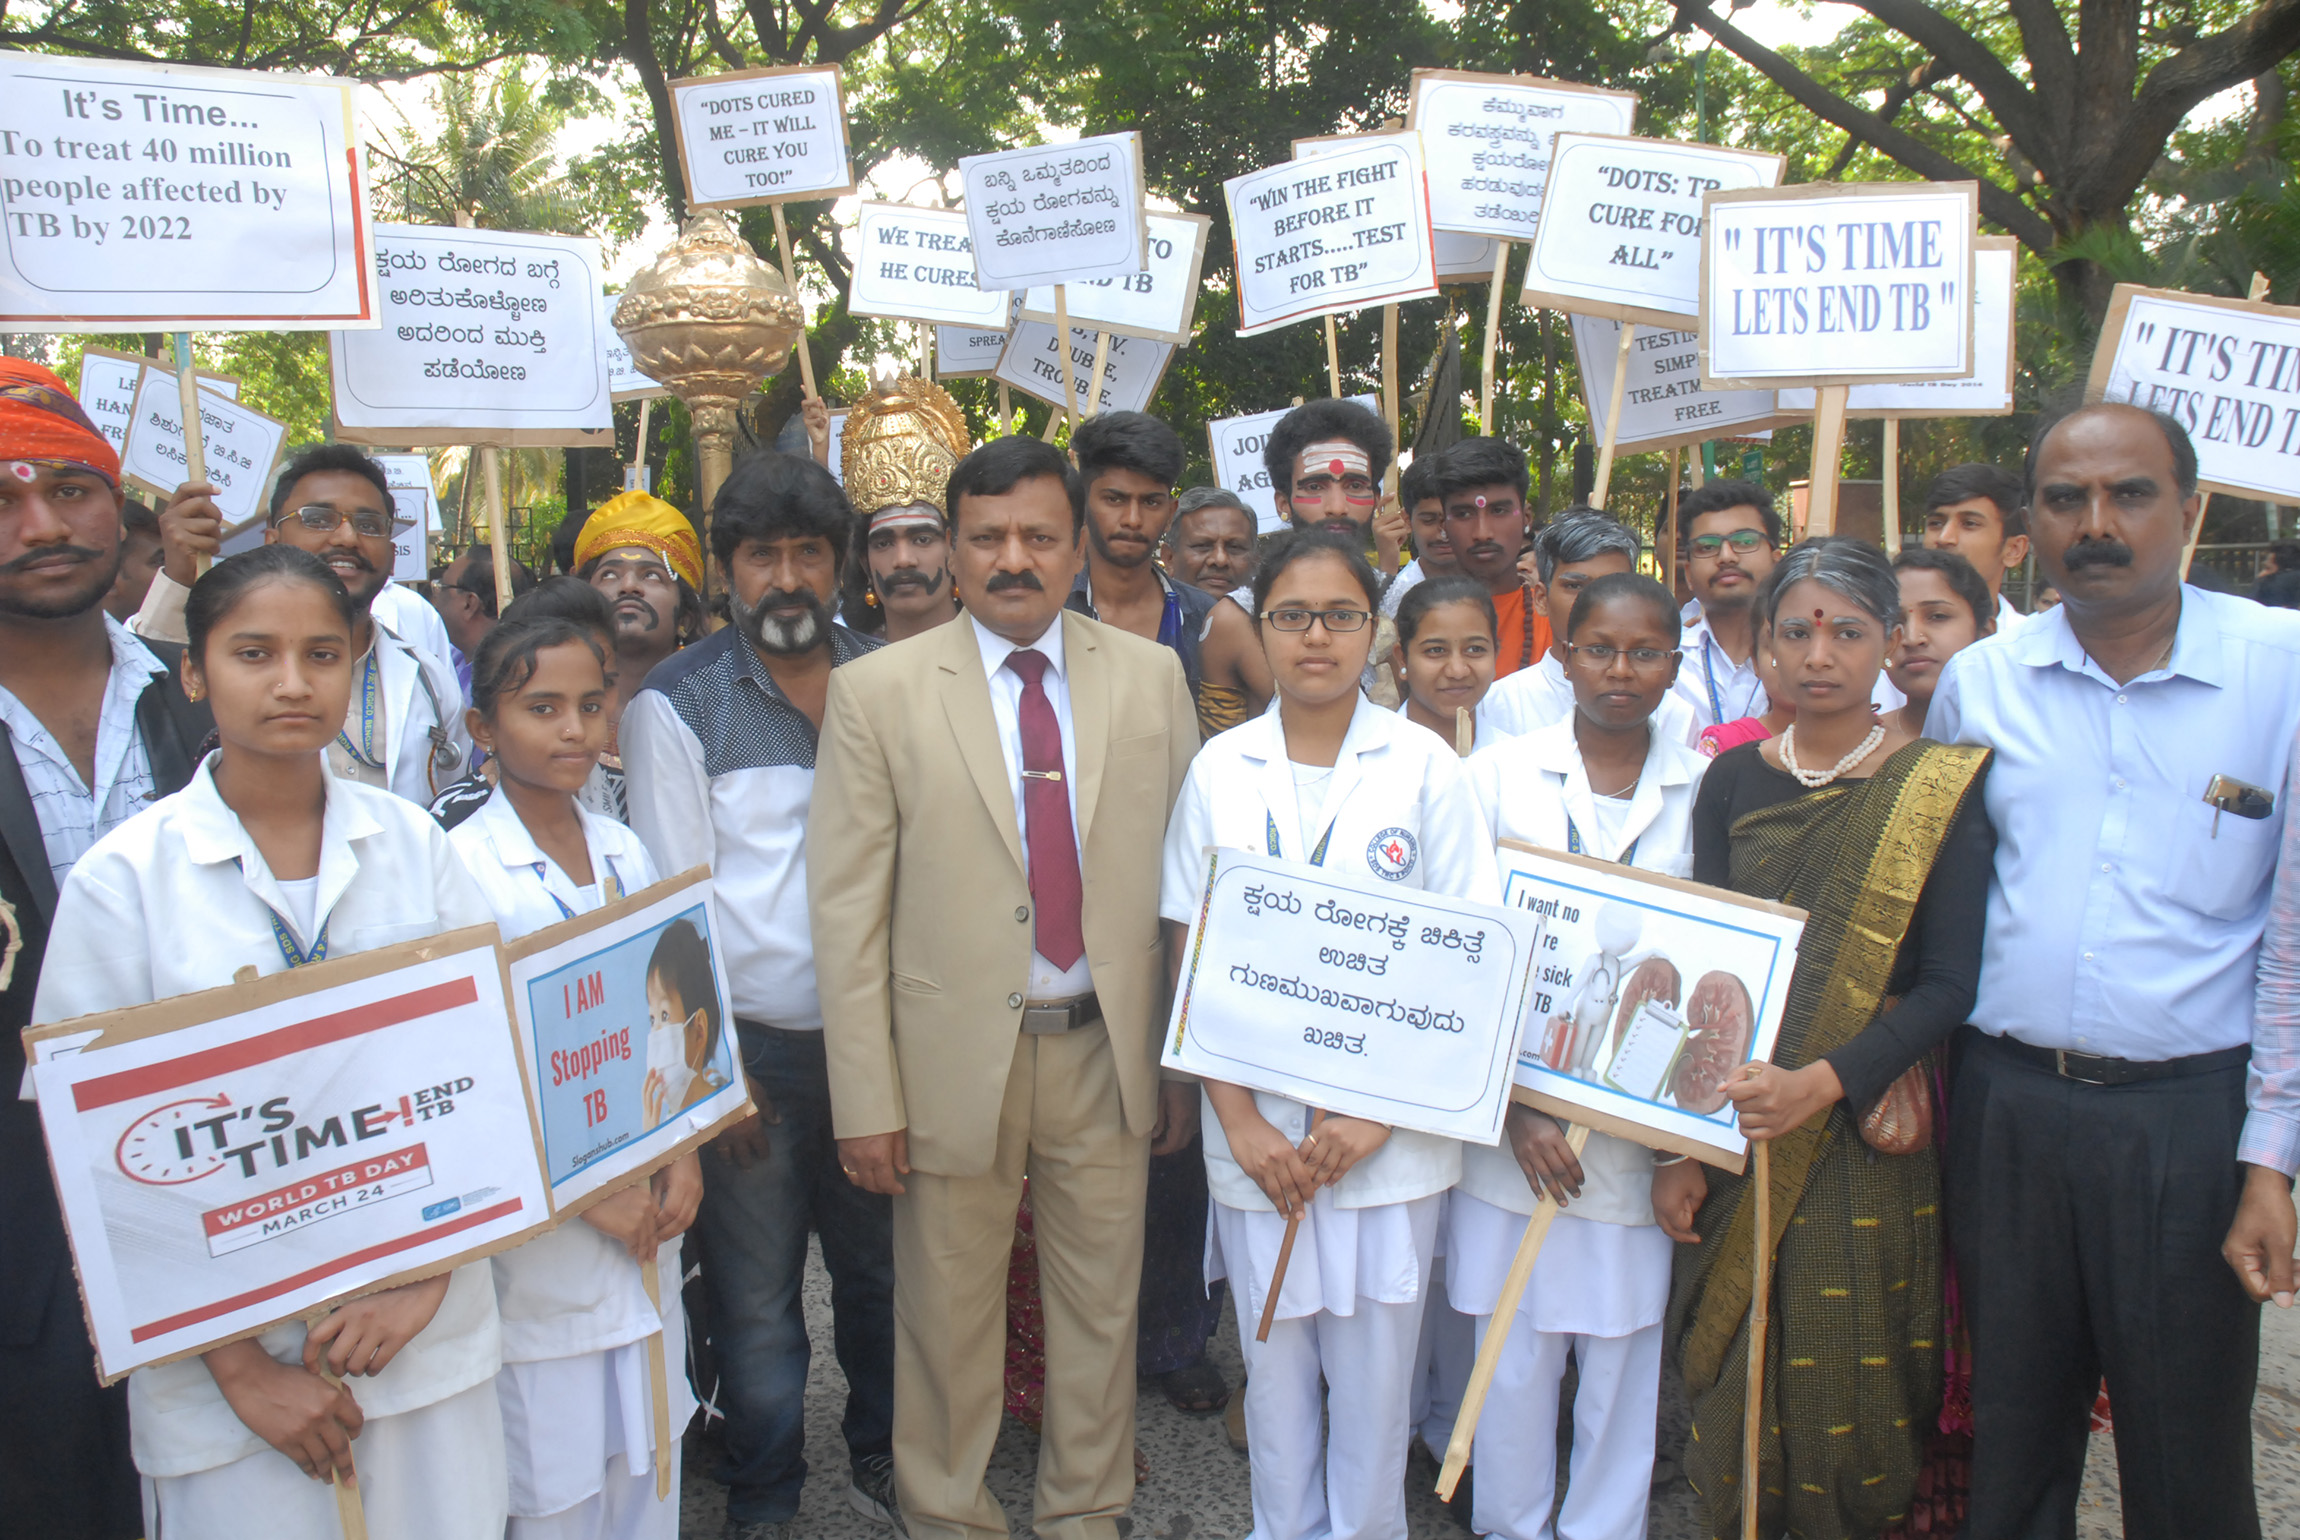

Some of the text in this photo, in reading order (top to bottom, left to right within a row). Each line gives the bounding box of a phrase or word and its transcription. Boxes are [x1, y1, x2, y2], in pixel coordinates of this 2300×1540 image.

[63, 89, 259, 129] It’s Time...
[757, 90, 815, 109] CURED
[709, 125, 736, 141] ME
[752, 121, 769, 136] IT
[773, 115, 817, 133] WILL
[0, 129, 293, 168] To treat 40 million
[723, 141, 808, 165] CURE YOU
[1472, 150, 1551, 171] ಕ್ಷಯರೋ
[984, 152, 1111, 191] ಬನ್ನಿ ಒಮ್ಮತದಿಂದ
[1292, 176, 1332, 200] THE
[1337, 160, 1398, 189] FIGHT
[3, 175, 287, 210] people affected by
[985, 185, 1120, 225] ಕ್ಷಯ ರೋಗವನ್ನು
[9, 212, 193, 245] TB by 2022
[1274, 197, 1375, 237] BEFORE IT
[1589, 203, 1655, 229] CURE
[878, 226, 972, 254] WE TREA
[1837, 220, 1943, 271] TIME
[376, 248, 560, 289] ಕ್ಷಯ ರೋಗದ ಬಗ್ಗೆ
[880, 262, 908, 280] HE
[1123, 273, 1153, 294] TB
[1290, 270, 1326, 294] FOR
[1732, 286, 1809, 336] LETS
[1816, 284, 1882, 333] END
[397, 322, 546, 353] ಅದರಿಂದ ಮುಕ್ತಿ
[969, 334, 1006, 348] SPREA
[423, 357, 526, 381] ಪಡೆಯೋಣ
[1654, 353, 1699, 374] SIMP
[1628, 378, 1702, 404] TREATM
[1674, 400, 1722, 421] FREE
[2202, 395, 2273, 448] END
[2277, 408, 2300, 456] T
[1518, 890, 1580, 923] I want no
[1243, 884, 1485, 964] ಕ್ಷಯ ರೋಗಕ್ಕೆ ಚಿಕಿತ್ಸೆ
[1543, 933, 1558, 951] re
[1319, 946, 1388, 976] ಉಚಿತ
[1542, 965, 1573, 987] sick
[564, 970, 605, 1019] I AM
[1230, 963, 1464, 1034] ಗುಣಮುಖವಾಗುವುದು
[1534, 992, 1552, 1013] TB
[551, 1026, 632, 1087] Stopping
[1519, 1050, 1540, 1061] .com
[413, 1077, 474, 1105] END
[416, 1100, 455, 1122] TB
[583, 1088, 608, 1128] TB
[572, 1131, 630, 1167] Sloganshub.com
[218, 1153, 415, 1226] WORLD TB DAY
[262, 1184, 384, 1235] MARCH 24
